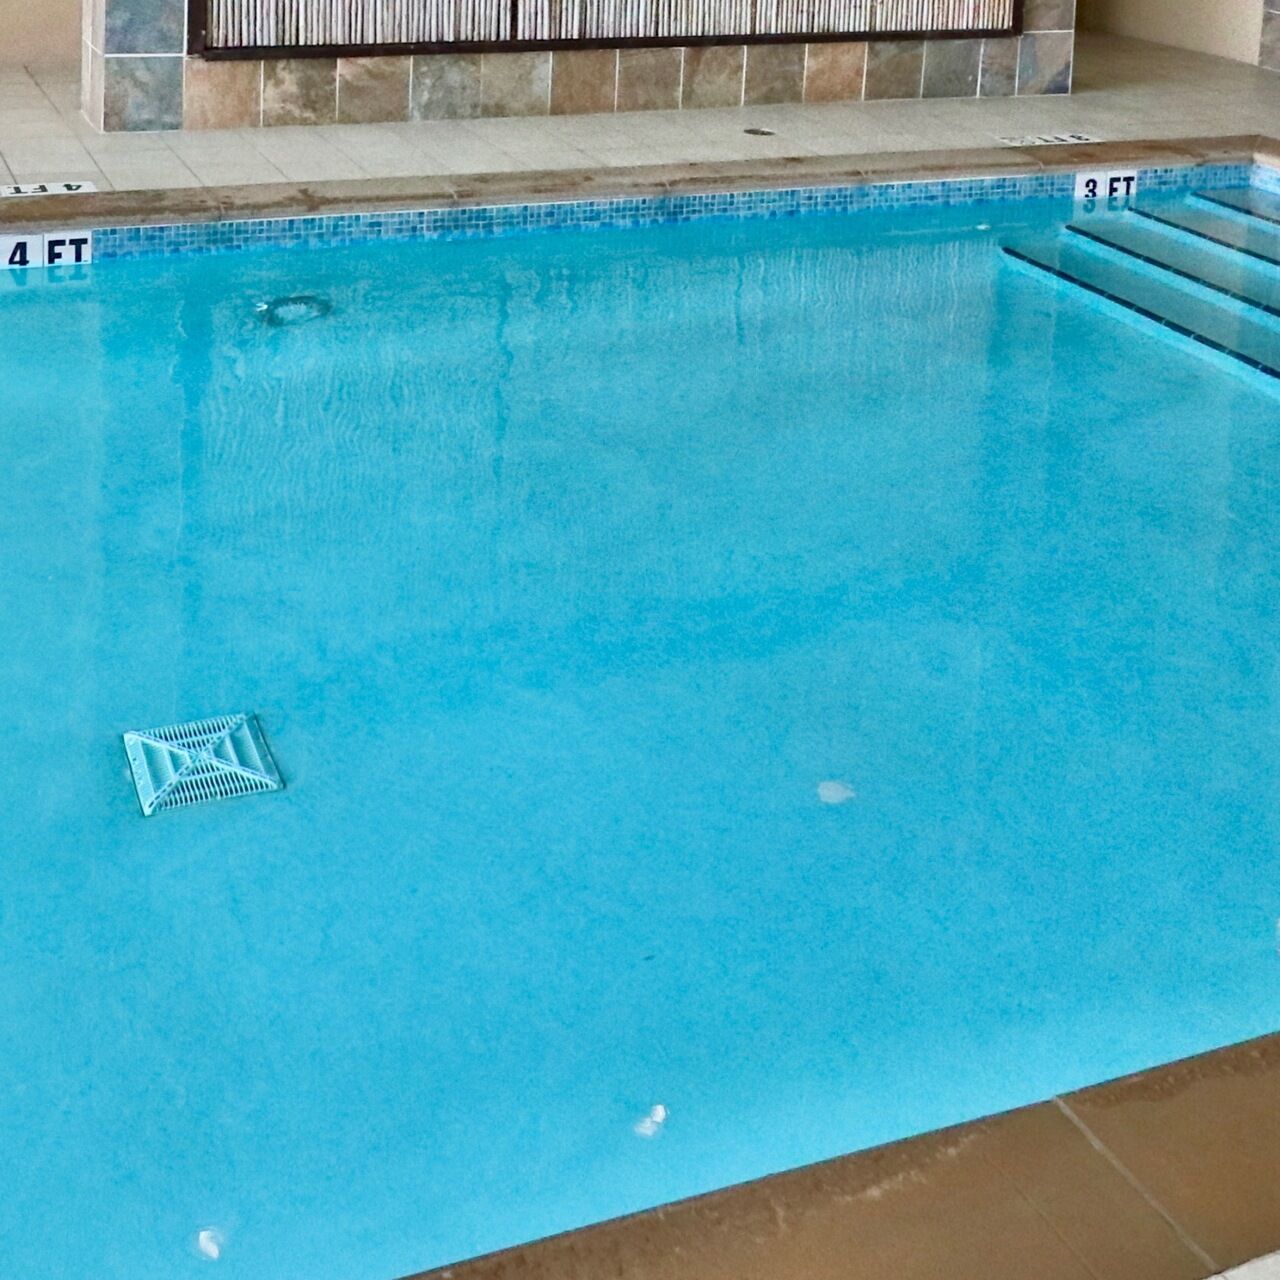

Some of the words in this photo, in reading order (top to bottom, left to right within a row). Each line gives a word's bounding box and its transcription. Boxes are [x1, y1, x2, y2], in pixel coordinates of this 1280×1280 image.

[9, 184, 48, 194] FT
[63, 183, 82, 191] 4
[1084, 179, 1097, 198] 3
[1109, 176, 1135, 197] FT
[8, 242, 29, 266] 4
[48, 238, 88, 264] FT
